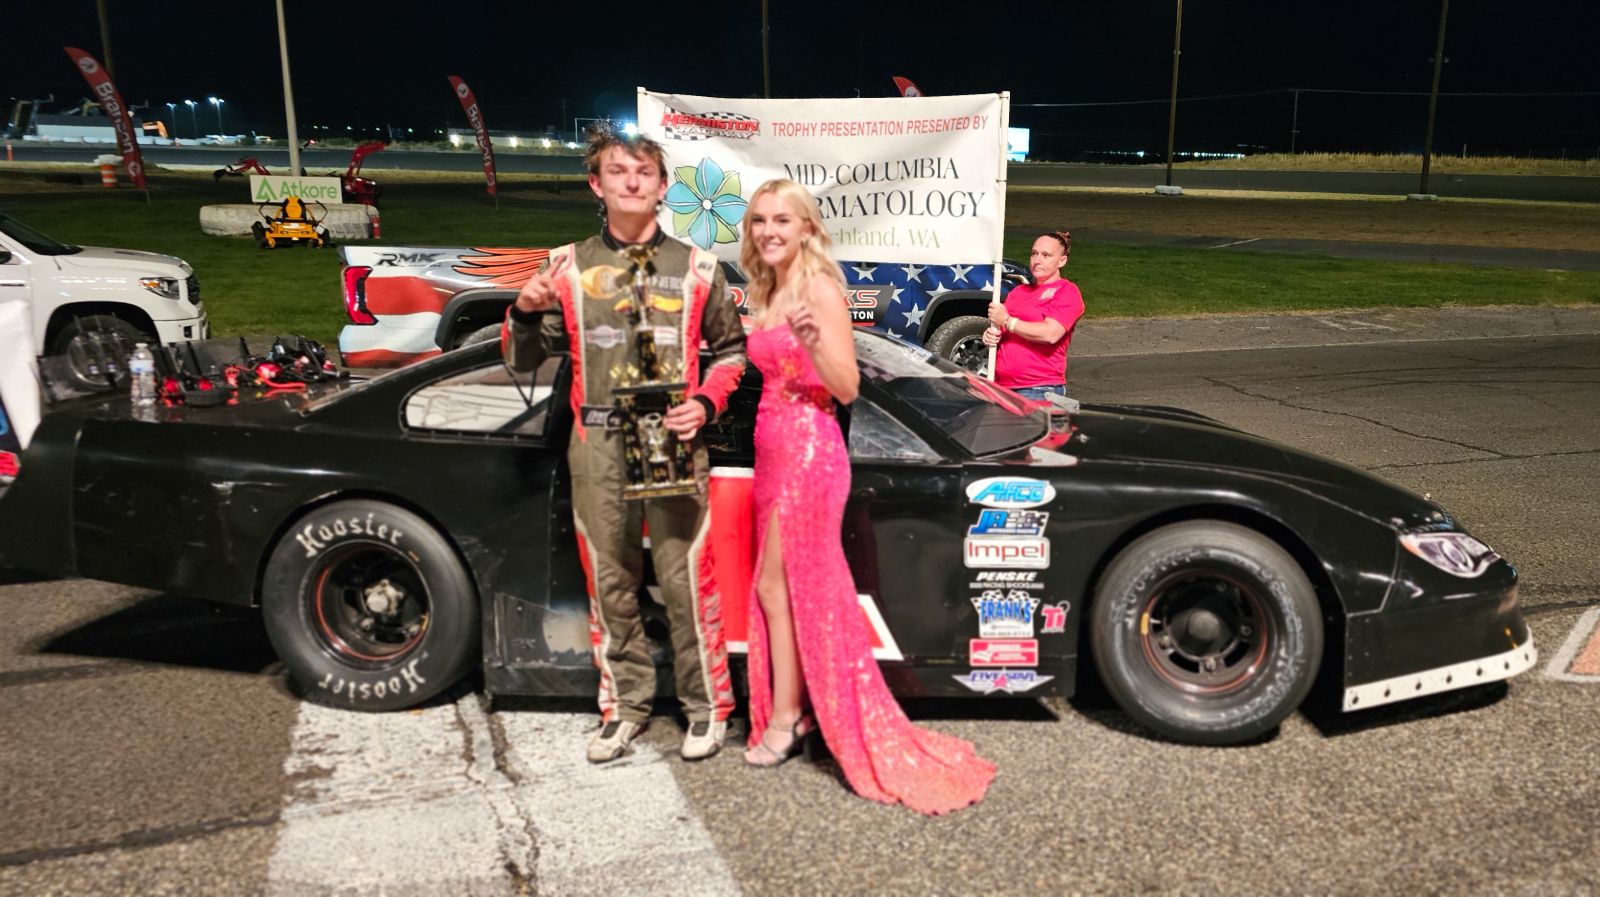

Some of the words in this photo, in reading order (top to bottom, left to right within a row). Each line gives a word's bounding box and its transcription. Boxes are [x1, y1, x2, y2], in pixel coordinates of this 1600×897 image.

[772, 121, 817, 137] TROPHY
[820, 120, 902, 137] PRESENTATION
[906, 115, 971, 134] PRESENTED
[972, 114, 989, 130] BY
[784, 157, 960, 186] MID-COLUMBIA
[280, 180, 338, 199] Atkore
[909, 229, 940, 248] WA
[375, 252, 446, 267] RMK
[295, 512, 404, 558] Hoosier
[968, 542, 1045, 562] Impel
[976, 571, 1038, 582] PENSKE
[317, 657, 426, 703] Hoosier
